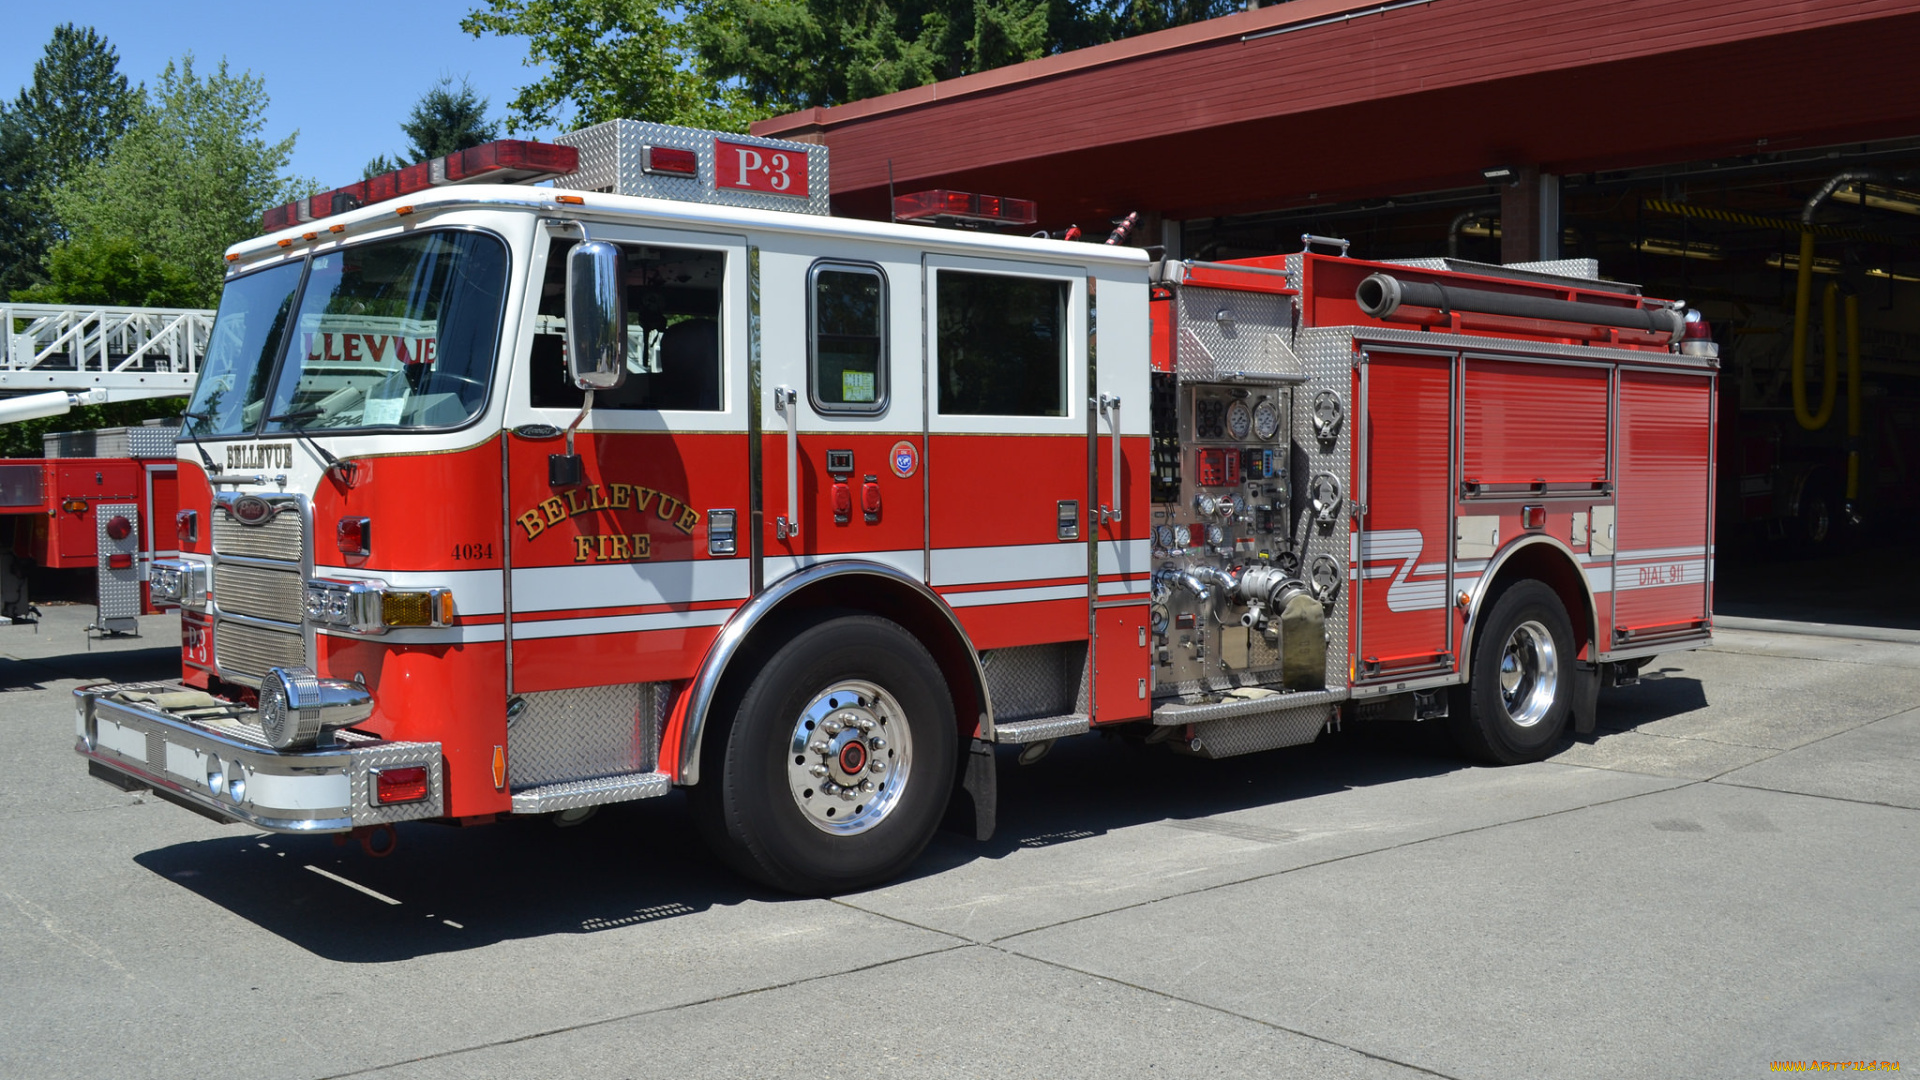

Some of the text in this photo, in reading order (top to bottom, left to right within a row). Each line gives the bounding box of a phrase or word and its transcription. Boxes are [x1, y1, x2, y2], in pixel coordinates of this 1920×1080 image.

[226, 443, 292, 469] BELLEVUE
[516, 483, 701, 542] BELLEVUE
[451, 543, 493, 560] 4034
[574, 533, 651, 562] FIRE
[1639, 564, 1684, 586] DIAL 911
